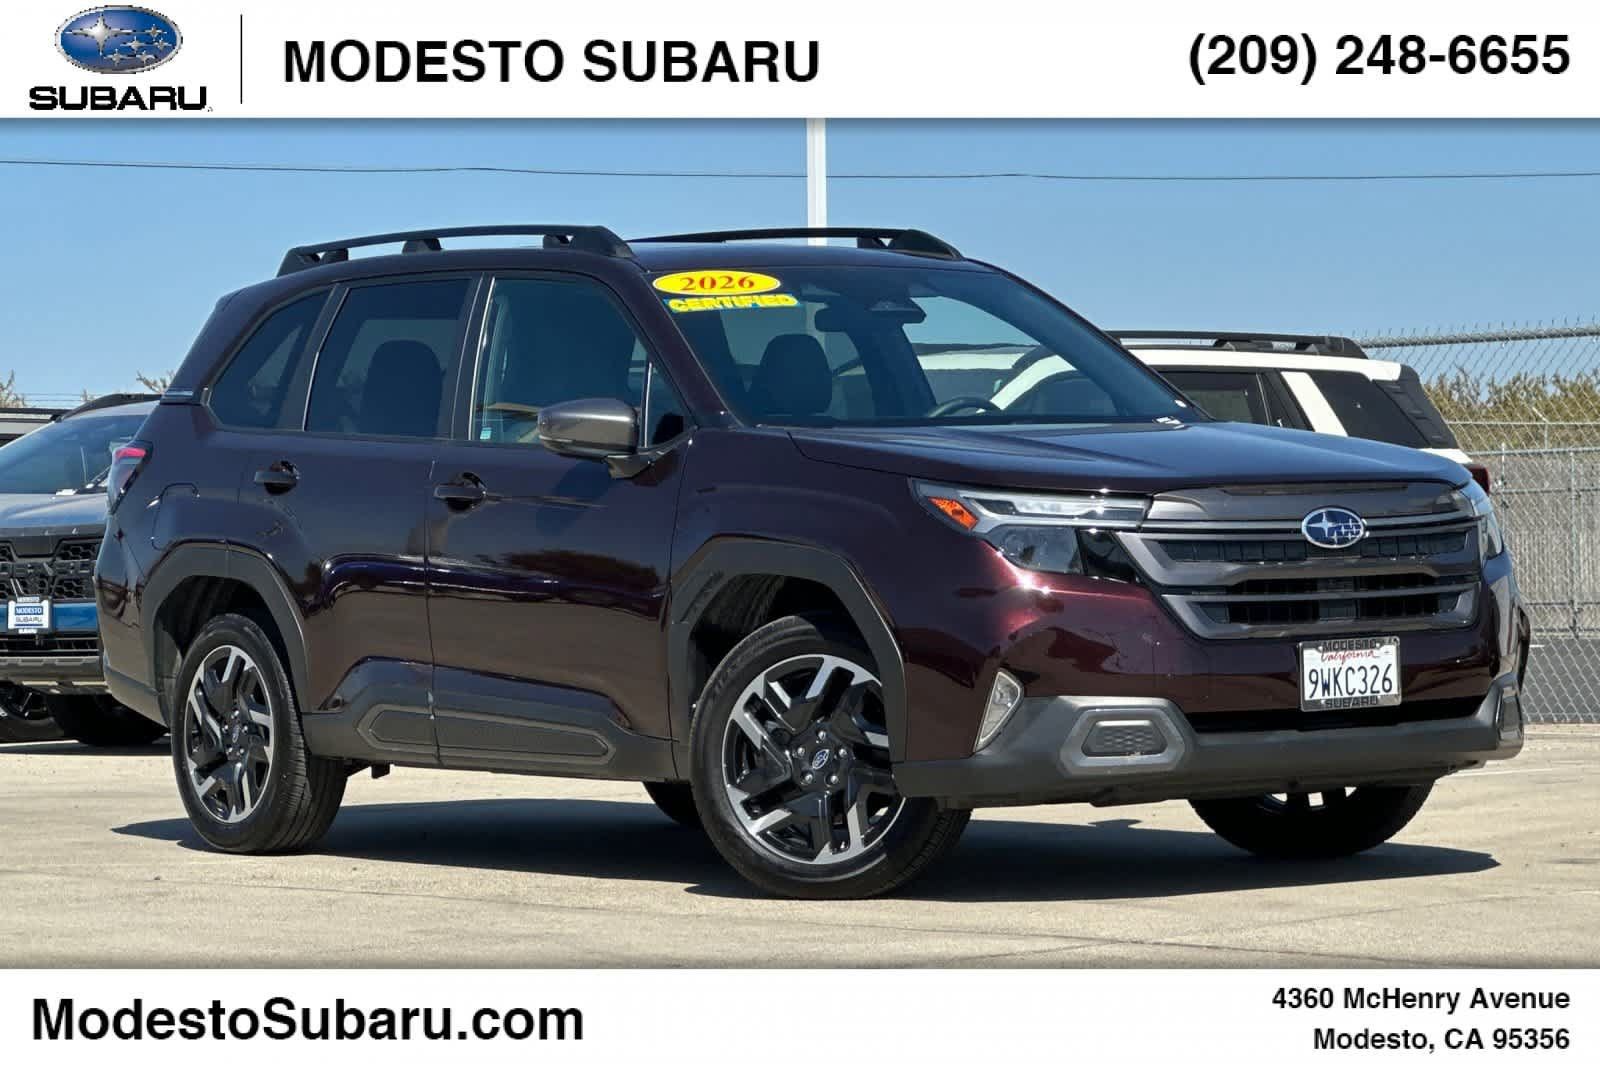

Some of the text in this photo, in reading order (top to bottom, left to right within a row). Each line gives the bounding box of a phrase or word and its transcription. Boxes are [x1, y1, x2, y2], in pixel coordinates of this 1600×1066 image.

[680, 275, 755, 291] 2026
[668, 293, 798, 312] CERTIFIED
[1322, 640, 1377, 652] MODESTO
[1320, 649, 1379, 665] California
[1308, 663, 1393, 699] 9WKC326
[1324, 695, 1378, 709] SUBARU
